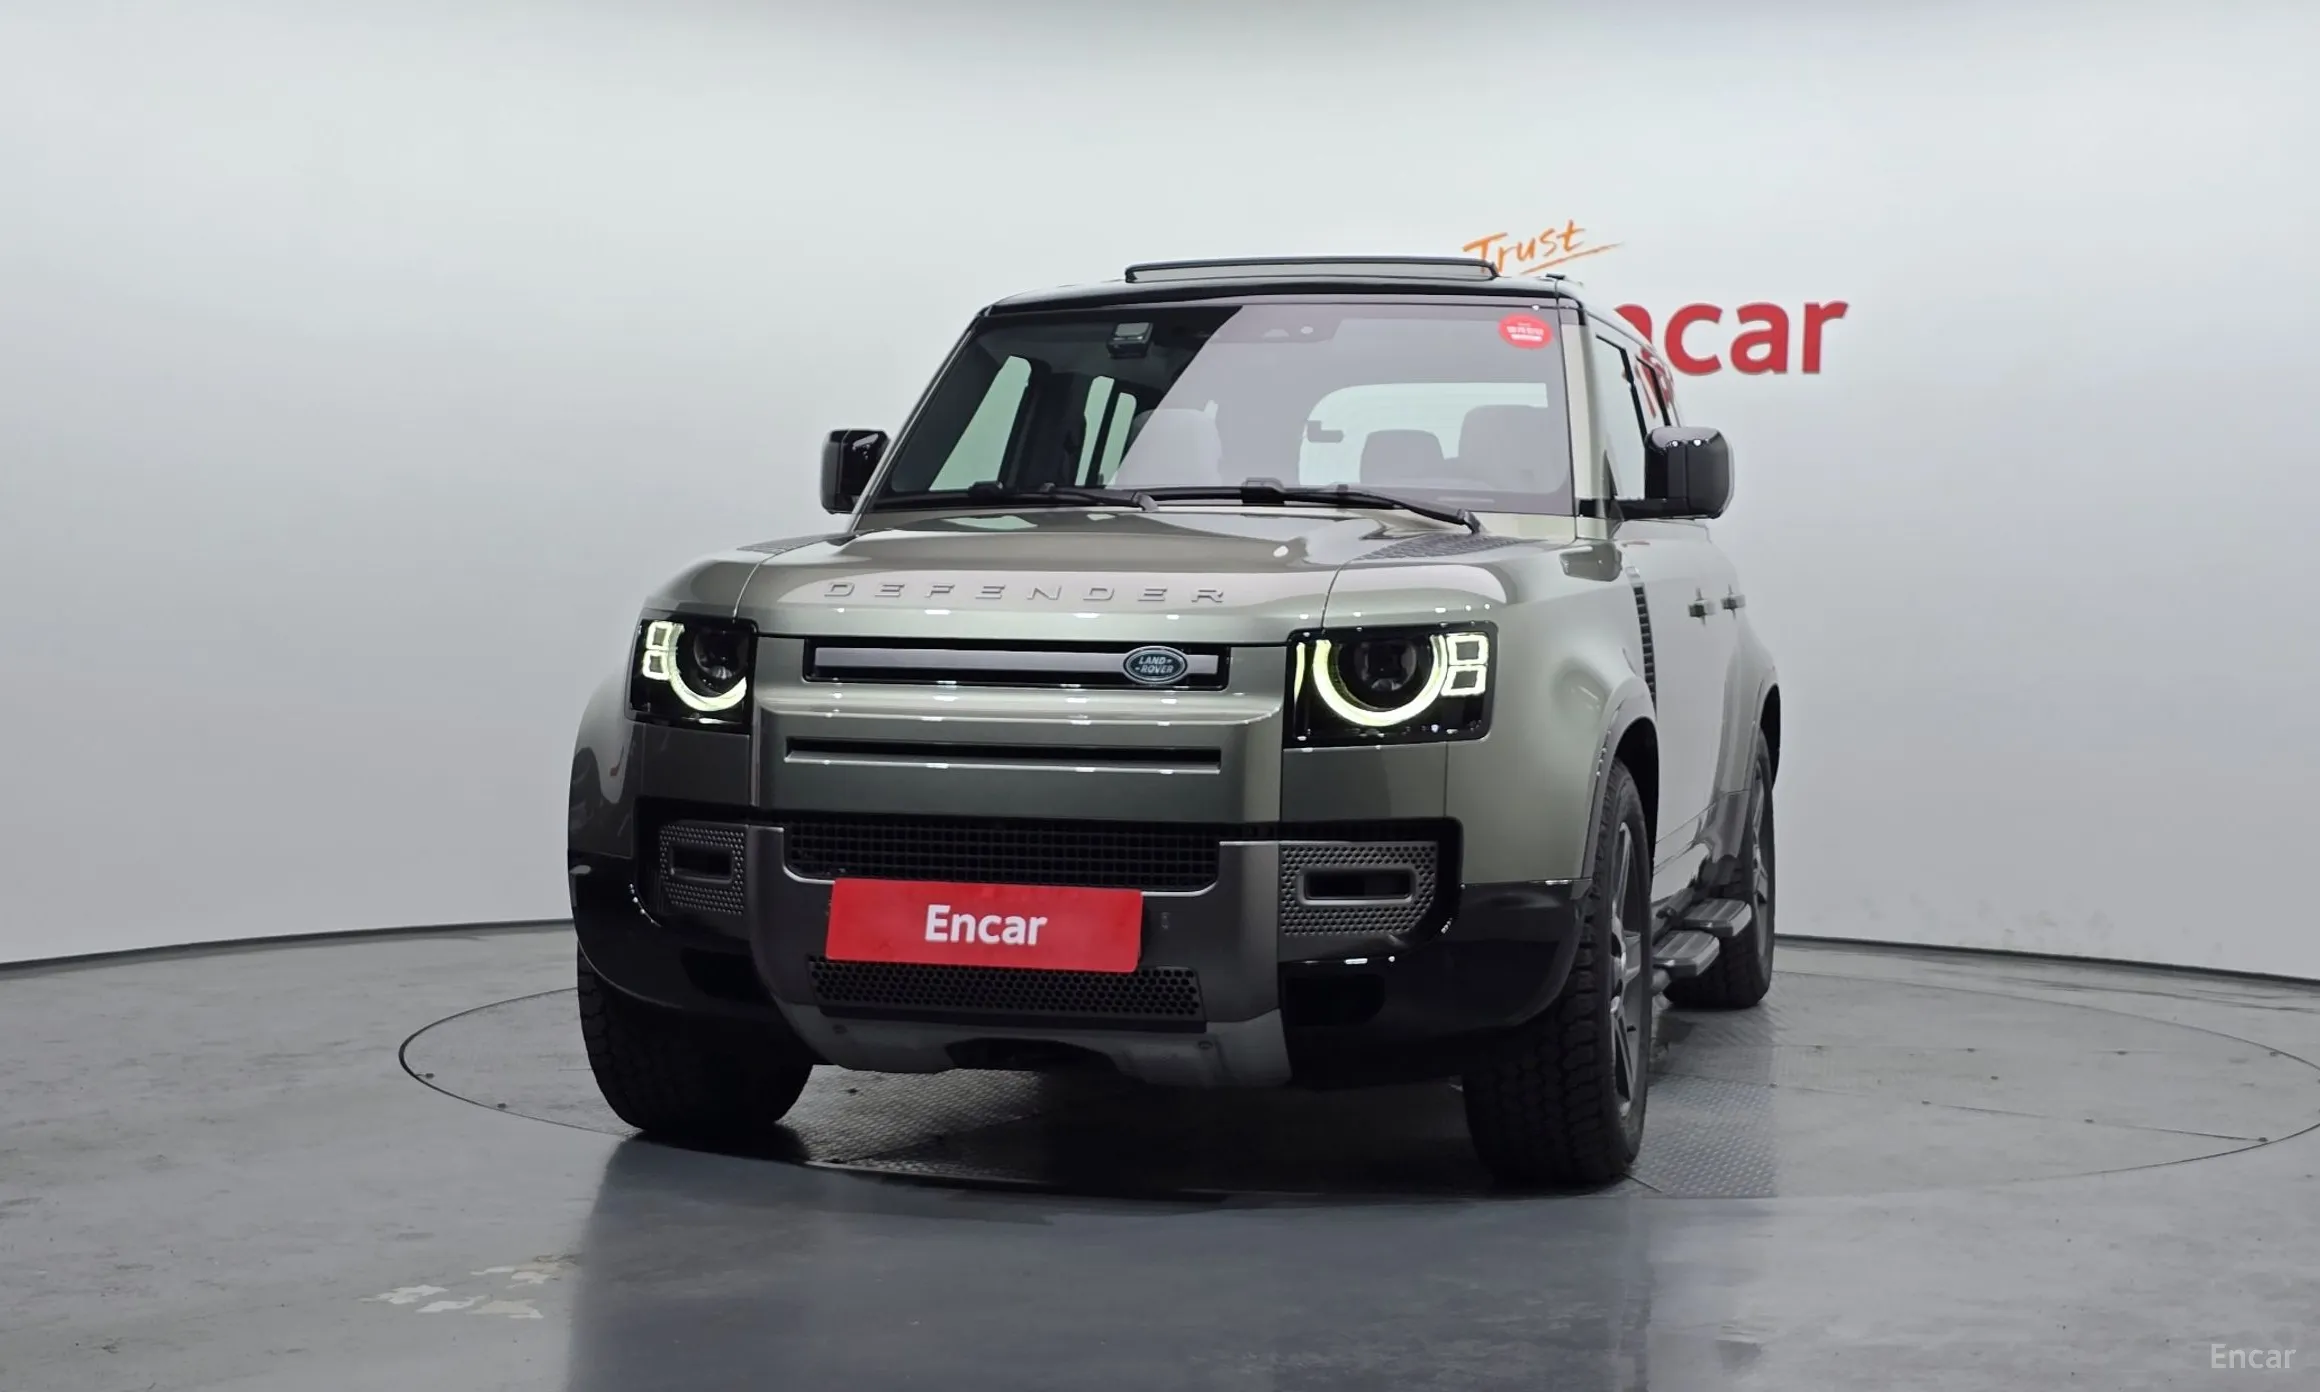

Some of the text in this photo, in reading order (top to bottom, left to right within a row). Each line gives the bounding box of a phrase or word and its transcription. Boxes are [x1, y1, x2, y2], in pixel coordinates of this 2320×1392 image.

[1462, 219, 1586, 273] Trust
[823, 581, 1225, 603] DEFENDER
[1138, 656, 1167, 665] LAND
[1140, 665, 1175, 674] ROVER
[924, 903, 1048, 946] Encar
